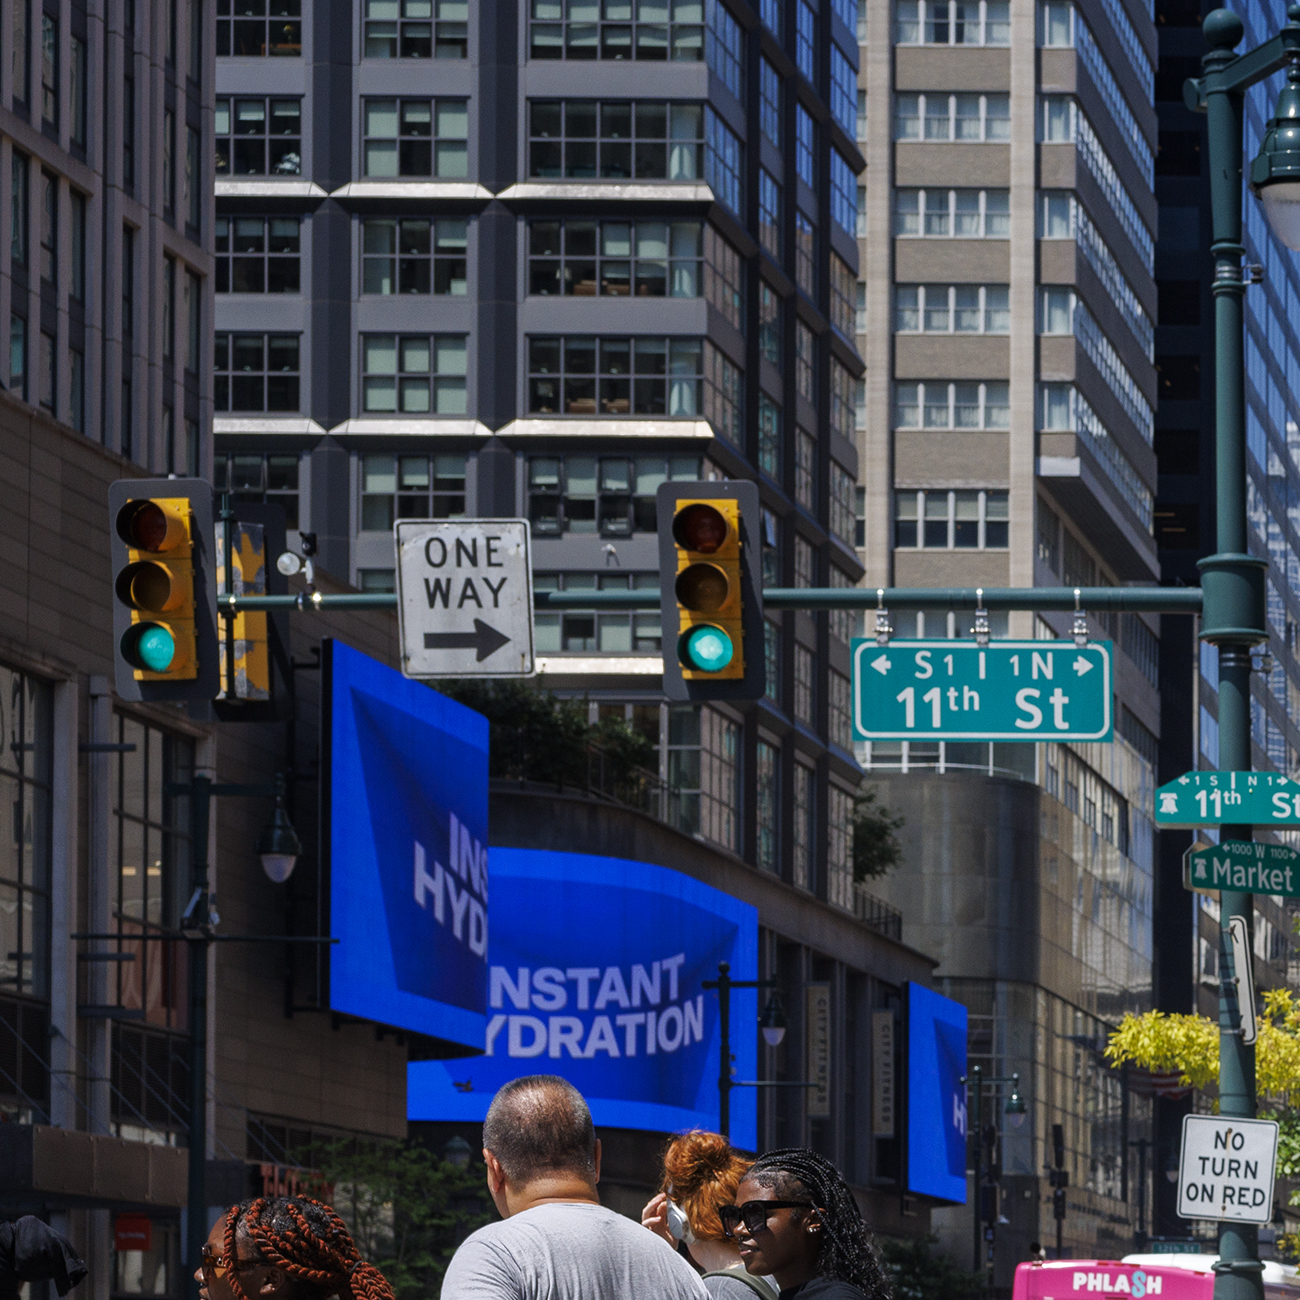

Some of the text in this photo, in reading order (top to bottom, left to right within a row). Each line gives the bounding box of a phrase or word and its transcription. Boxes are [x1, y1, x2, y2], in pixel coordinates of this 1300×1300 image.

[424, 536, 503, 568] ONE
[424, 577, 507, 609] WAY
[896, 685, 1070, 730] 11th St
[1195, 788, 1241, 818] 11th
[1231, 844, 1288, 860] 1000 W 1100
[1213, 857, 1293, 892] Market
[1214, 1130, 1245, 1151] NO
[1198, 1156, 1258, 1180] TURN
[1186, 1182, 1266, 1207] ON RED
[1073, 1271, 1162, 1298] PHLASH
